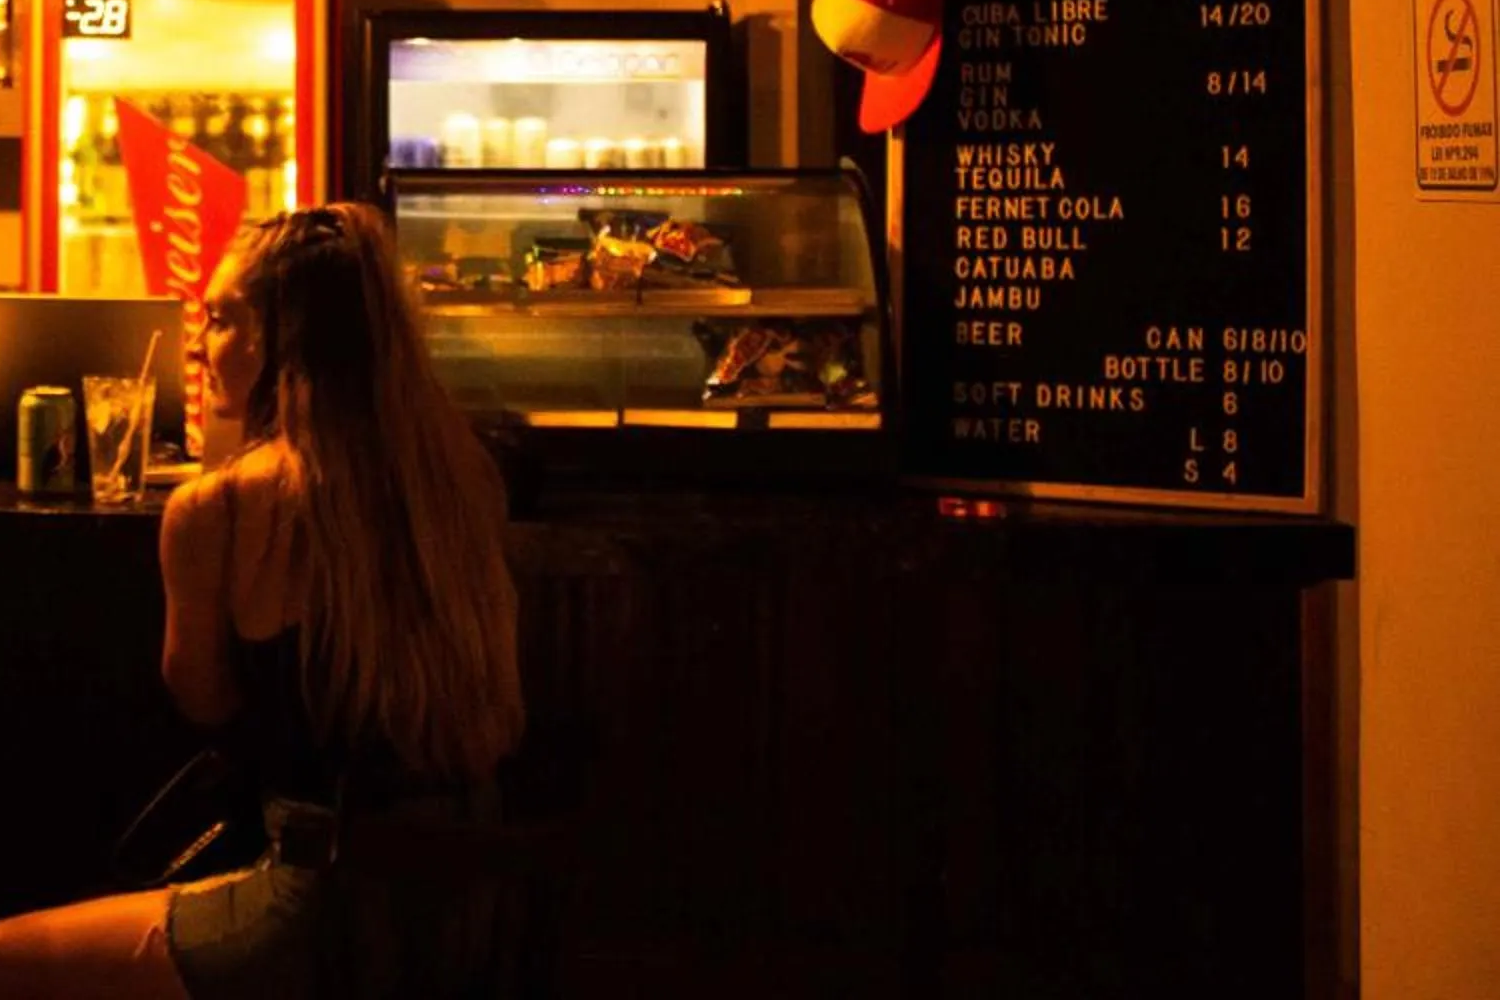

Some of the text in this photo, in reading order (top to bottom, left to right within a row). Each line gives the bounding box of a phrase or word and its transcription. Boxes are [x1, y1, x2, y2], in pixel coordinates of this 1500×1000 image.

[962, 3, 1021, 26] CUBA
[1200, 2, 1271, 27] 14/20
[959, 23, 1086, 49] GIN TONIC
[960, 62, 1266, 94] RUM 8/14
[960, 85, 1008, 108] GIN
[957, 108, 1043, 131] VODKA
[955, 143, 1250, 169] WHISKY 14
[954, 167, 1065, 190] TEQUILA
[955, 195, 1251, 220] FERNET COLA 16
[957, 226, 1252, 251] RED BULL 12
[954, 256, 1076, 280] CATUABA
[954, 286, 1041, 310] JAMBU
[956, 321, 1024, 346] BEER
[1146, 326, 1306, 353] CAN 6/8/10
[1104, 355, 1205, 382] BOTTLE
[953, 382, 1239, 416] SOFT DRINKS 6
[953, 418, 1238, 452] WATER L 8
[1184, 459, 1238, 485] S 4
